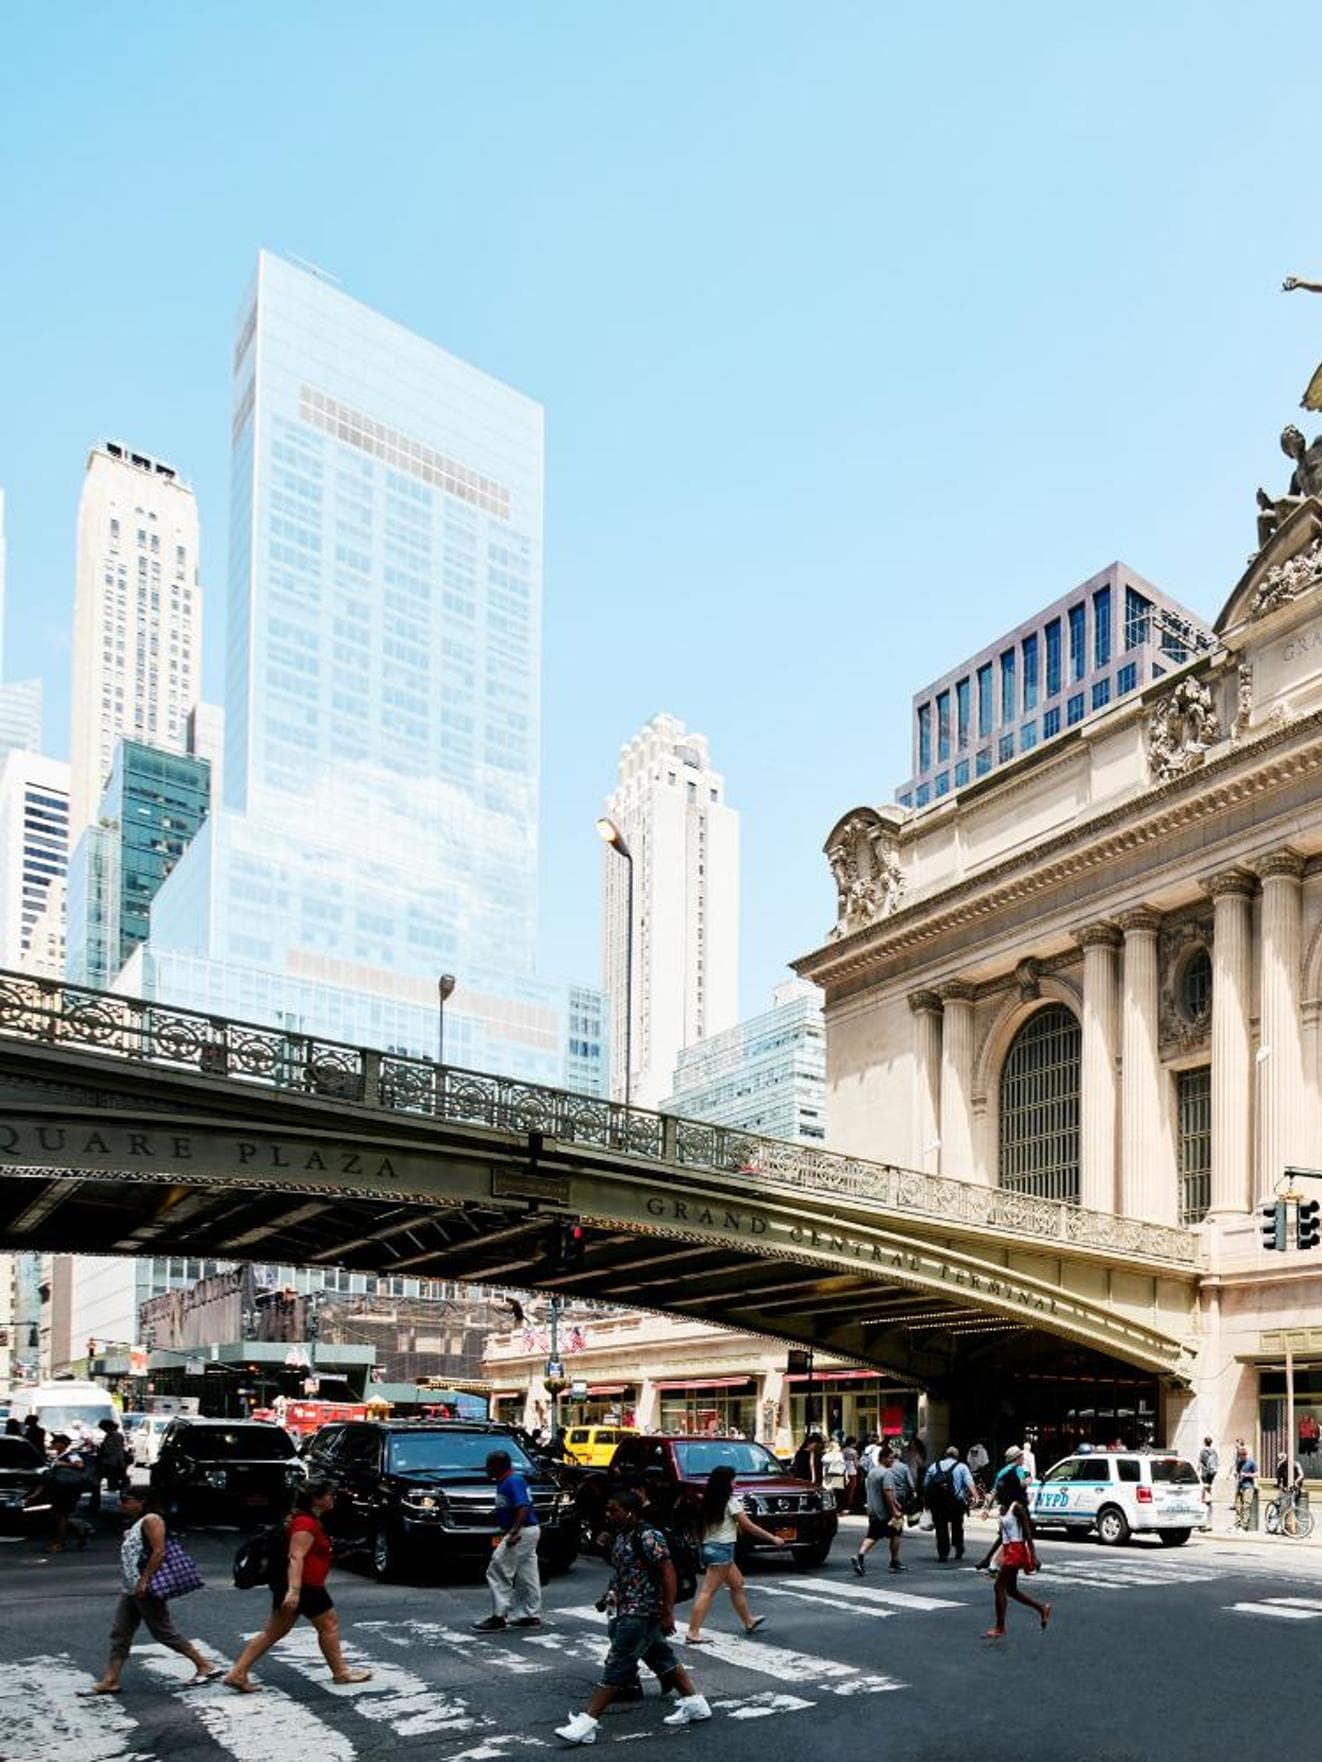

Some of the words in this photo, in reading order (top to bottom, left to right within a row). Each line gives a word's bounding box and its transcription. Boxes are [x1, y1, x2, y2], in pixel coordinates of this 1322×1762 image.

[238, 1142, 400, 1178] PLAZA
[646, 1198, 767, 1234] GRAND
[790, 1226, 920, 1272] CENTRAL
[941, 1264, 1059, 1315] TERMINAL
[1034, 1492, 1069, 1508] NYPD
